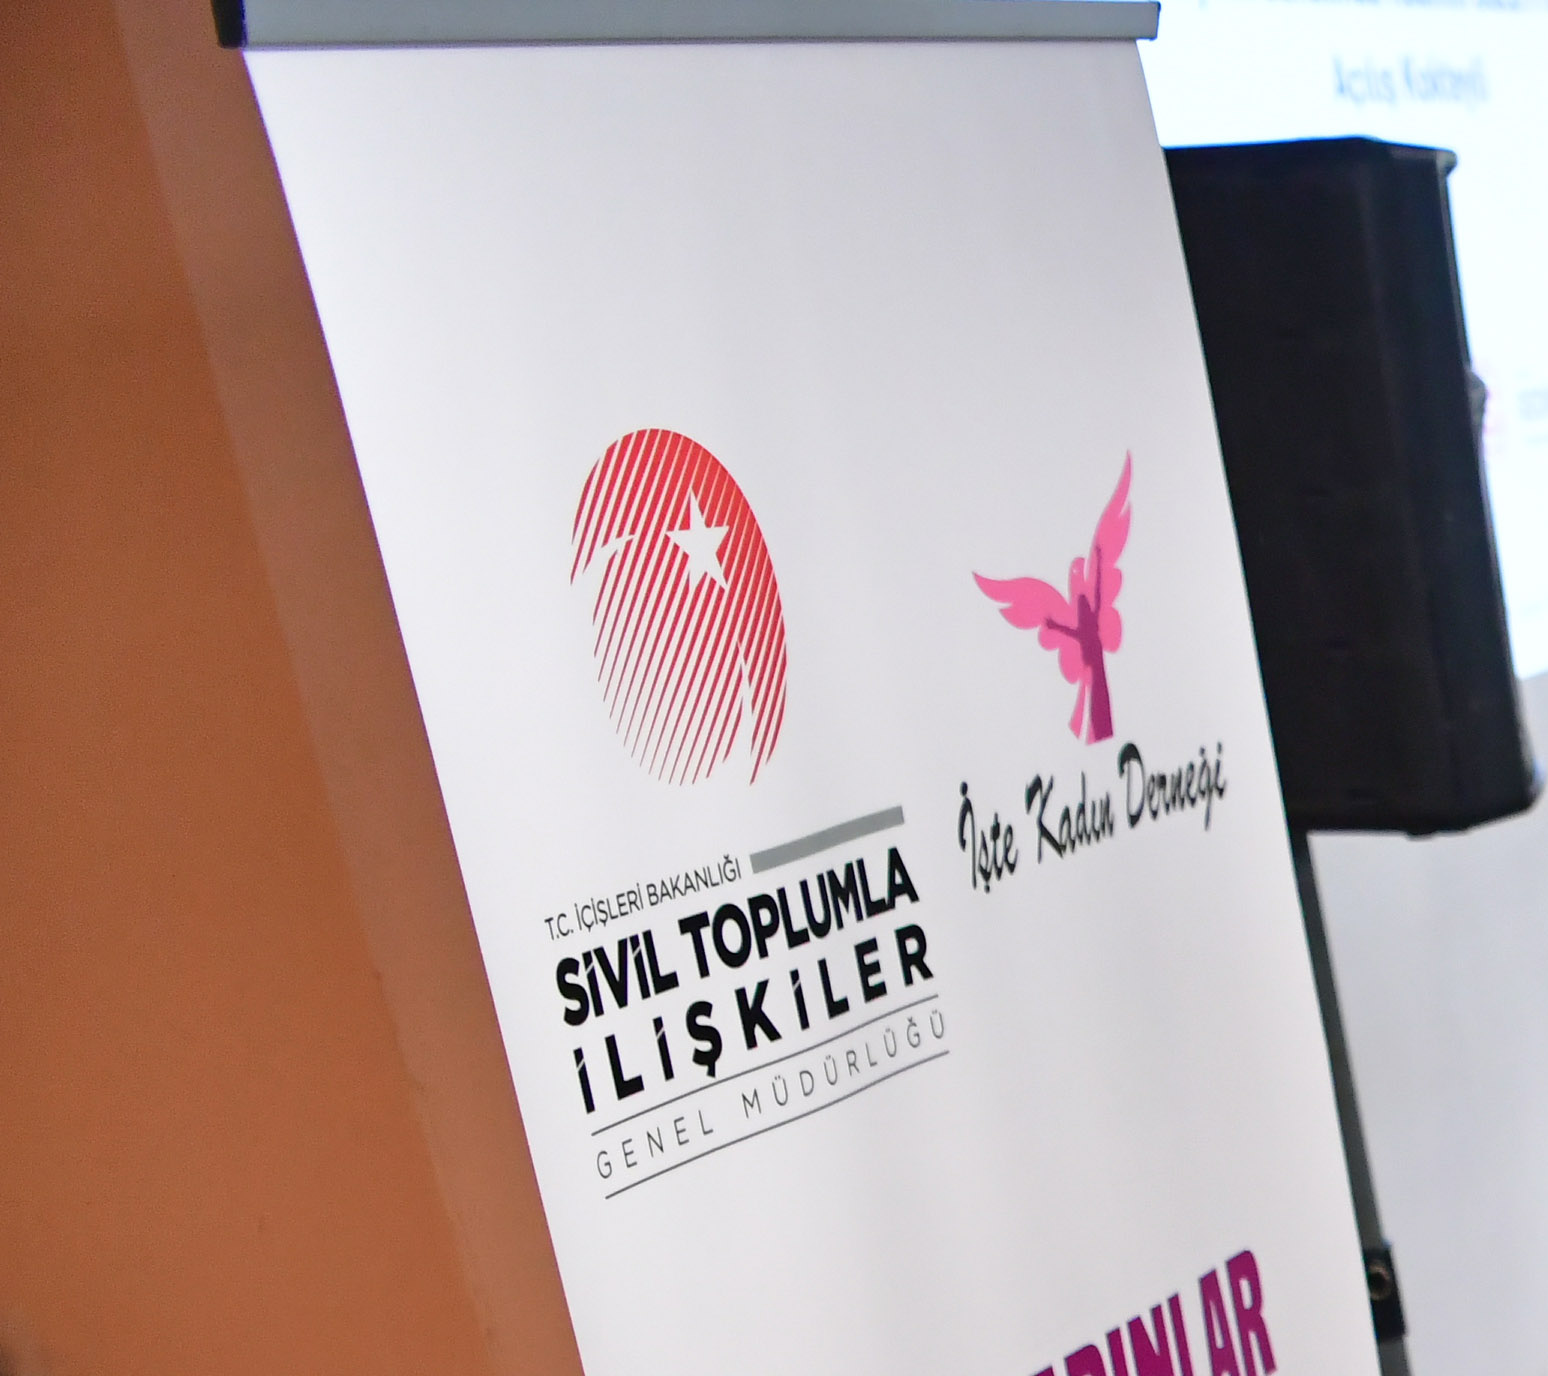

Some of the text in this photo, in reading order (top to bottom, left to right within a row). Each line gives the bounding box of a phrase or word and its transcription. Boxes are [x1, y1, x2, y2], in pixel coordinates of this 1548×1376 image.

[545, 853, 743, 941] T.C. İÇİŞLERİ BAKANLIĞI
[957, 740, 1228, 894] İşte Kadın Derneği
[555, 846, 920, 1027] SİVİL TOPLUMLA
[572, 923, 935, 1114] İLİŞKİLER
[596, 1009, 946, 1180] GENEL MÜDÜRLÜĞÜ
